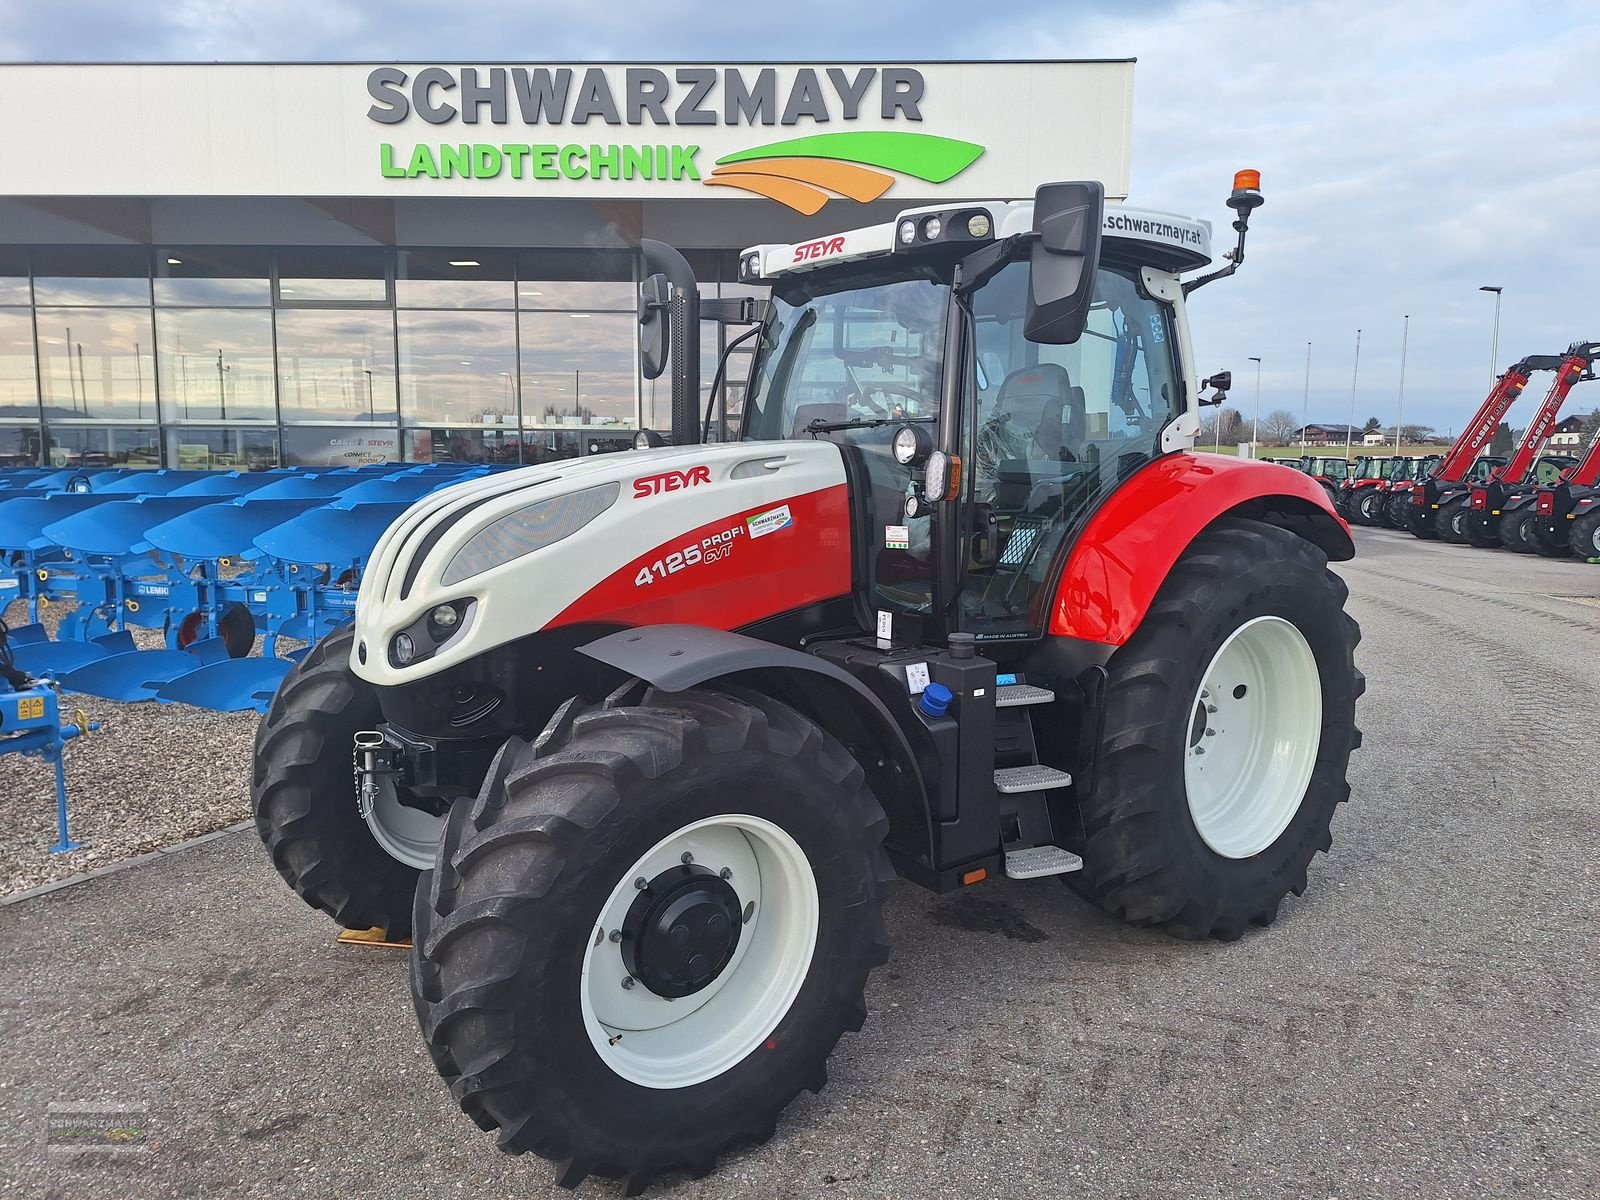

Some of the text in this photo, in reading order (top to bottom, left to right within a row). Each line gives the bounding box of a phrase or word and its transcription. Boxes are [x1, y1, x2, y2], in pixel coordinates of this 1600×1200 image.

[367, 67, 926, 127] SCHWARZMAYR
[380, 142, 702, 180] LANDTECHNIK
[793, 236, 845, 263] STEYR
[633, 465, 713, 499] STEYR
[752, 512, 785, 527] SCHWARZMAYR
[634, 525, 745, 587] 4125 PROFI
[703, 543, 733, 565] CVT
